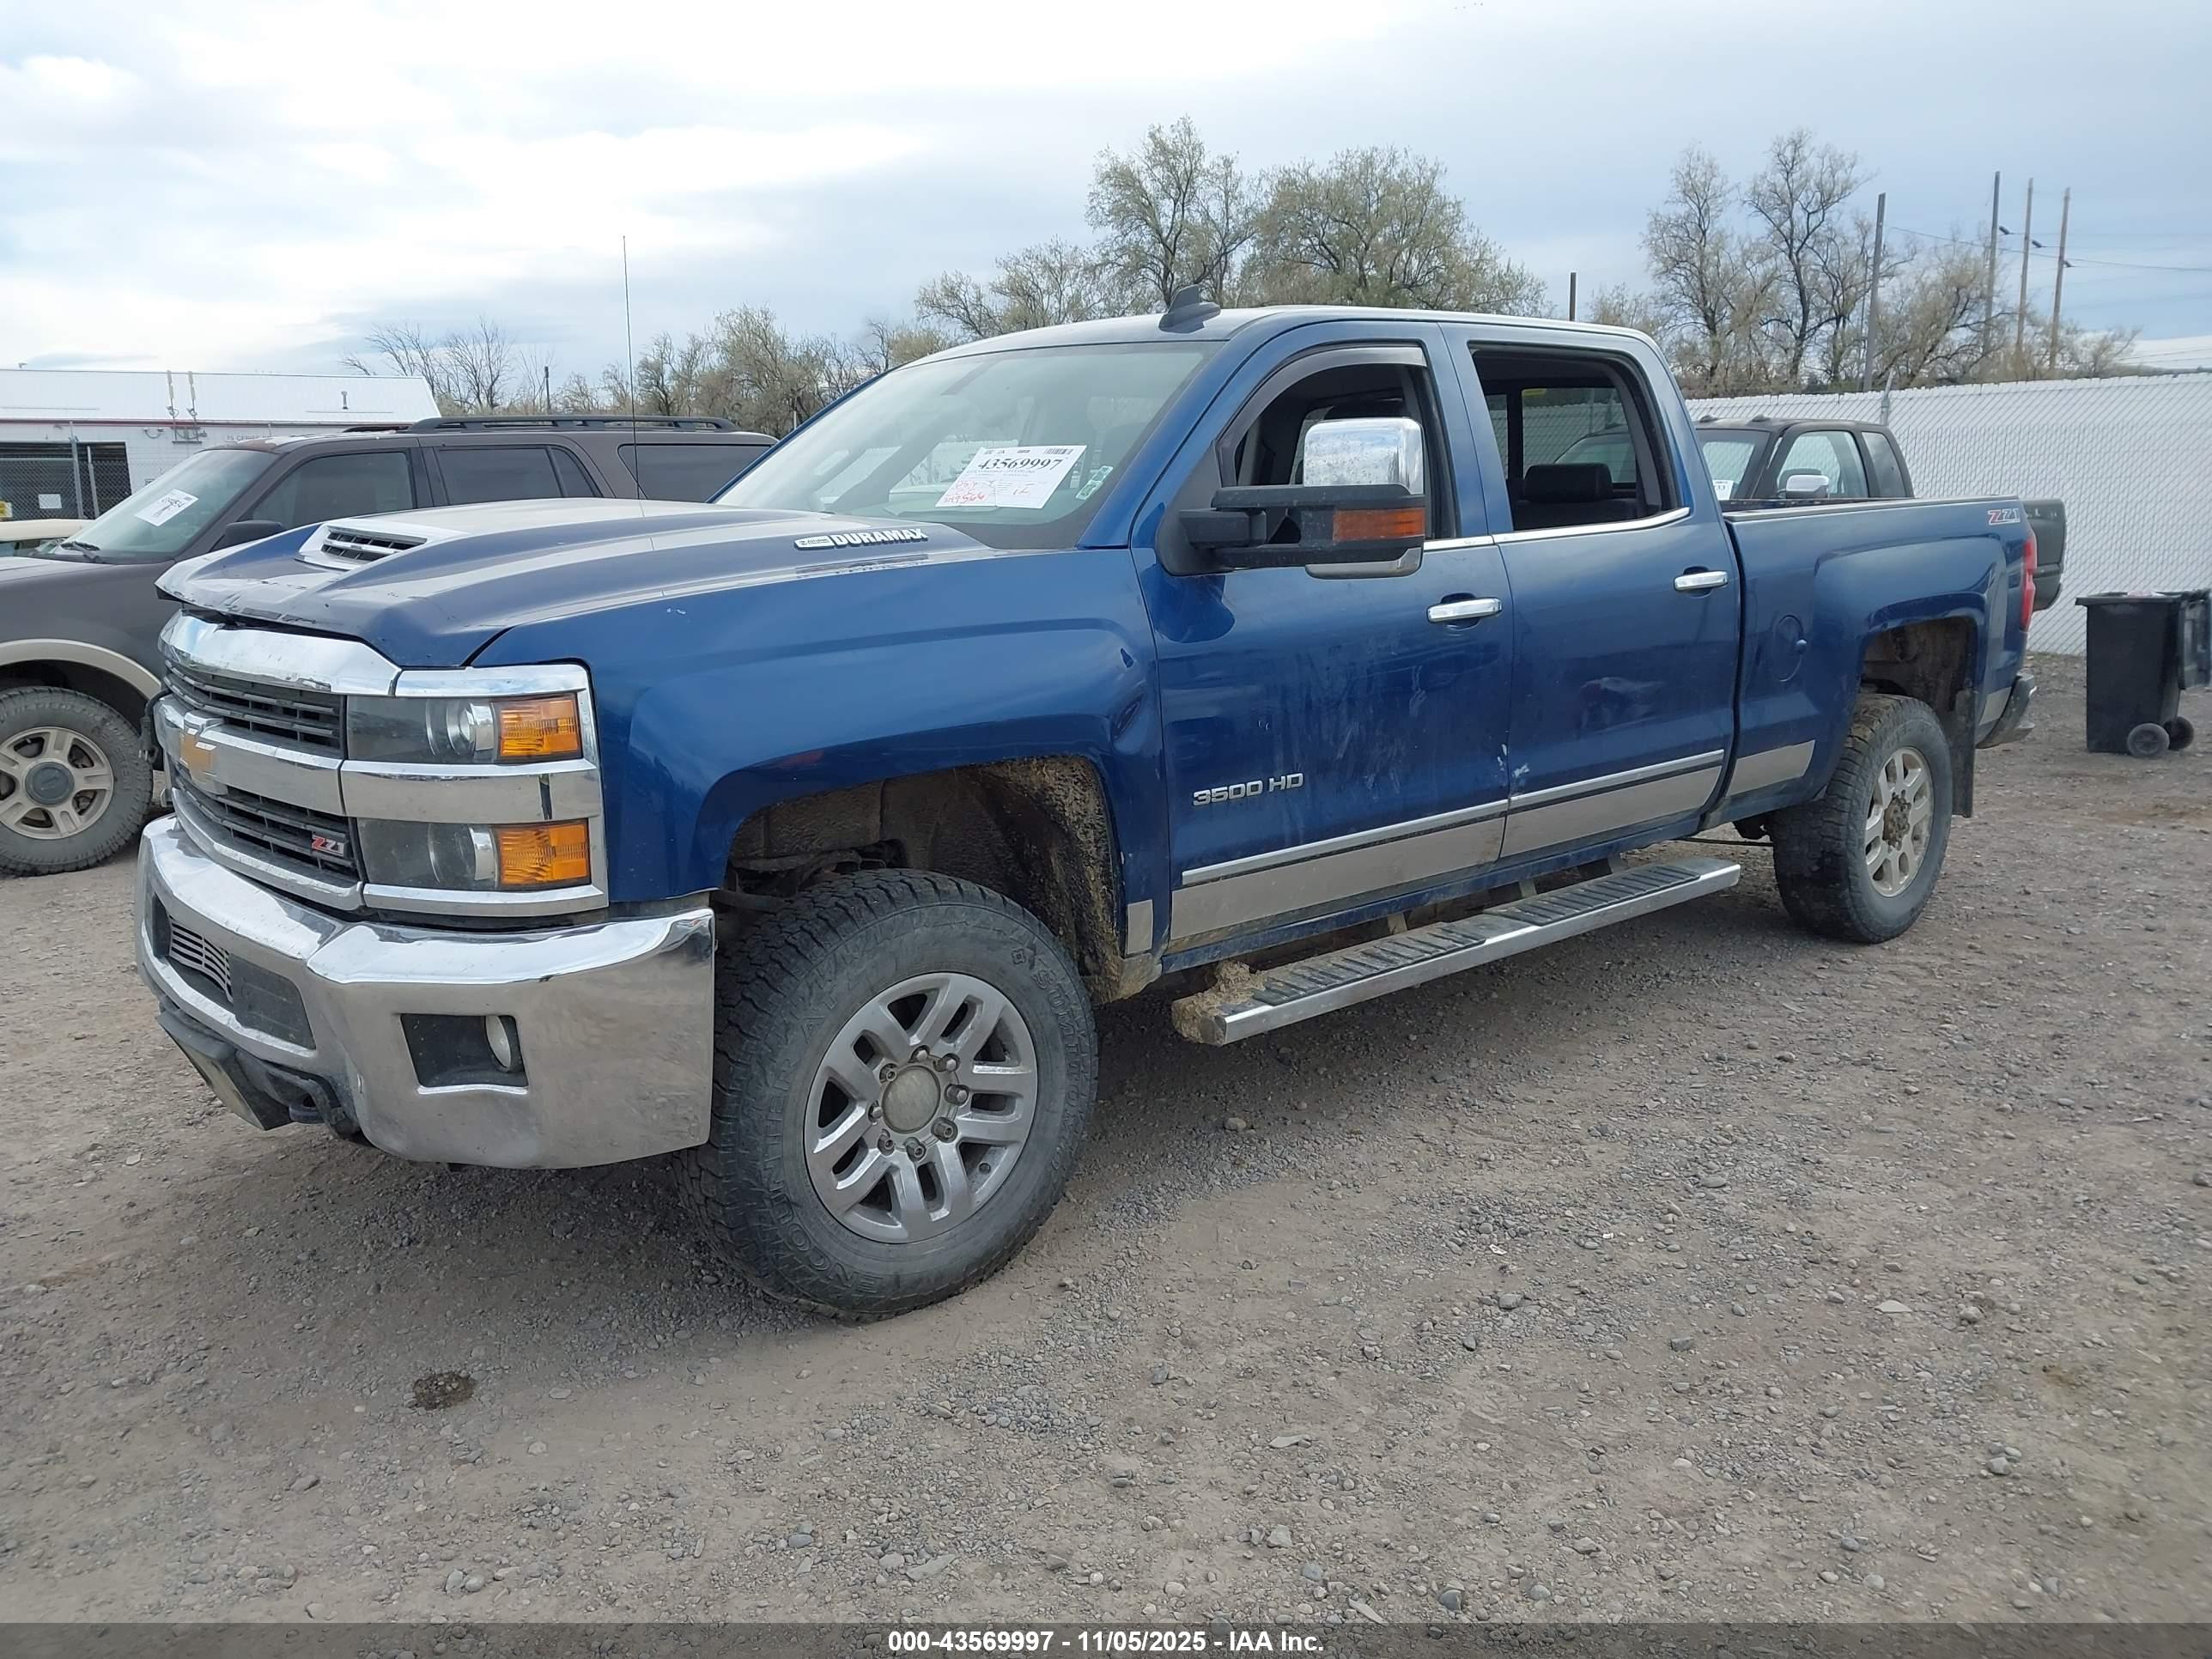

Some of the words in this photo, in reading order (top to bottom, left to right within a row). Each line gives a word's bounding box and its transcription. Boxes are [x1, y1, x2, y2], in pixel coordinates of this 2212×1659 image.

[977, 458, 1064, 471] 43569997
[1987, 507, 2021, 525] Z71
[830, 528, 929, 547] DURAMAX
[1193, 780, 1263, 806] 3500
[1268, 772, 1304, 793] HD
[312, 834, 344, 856] Z71
